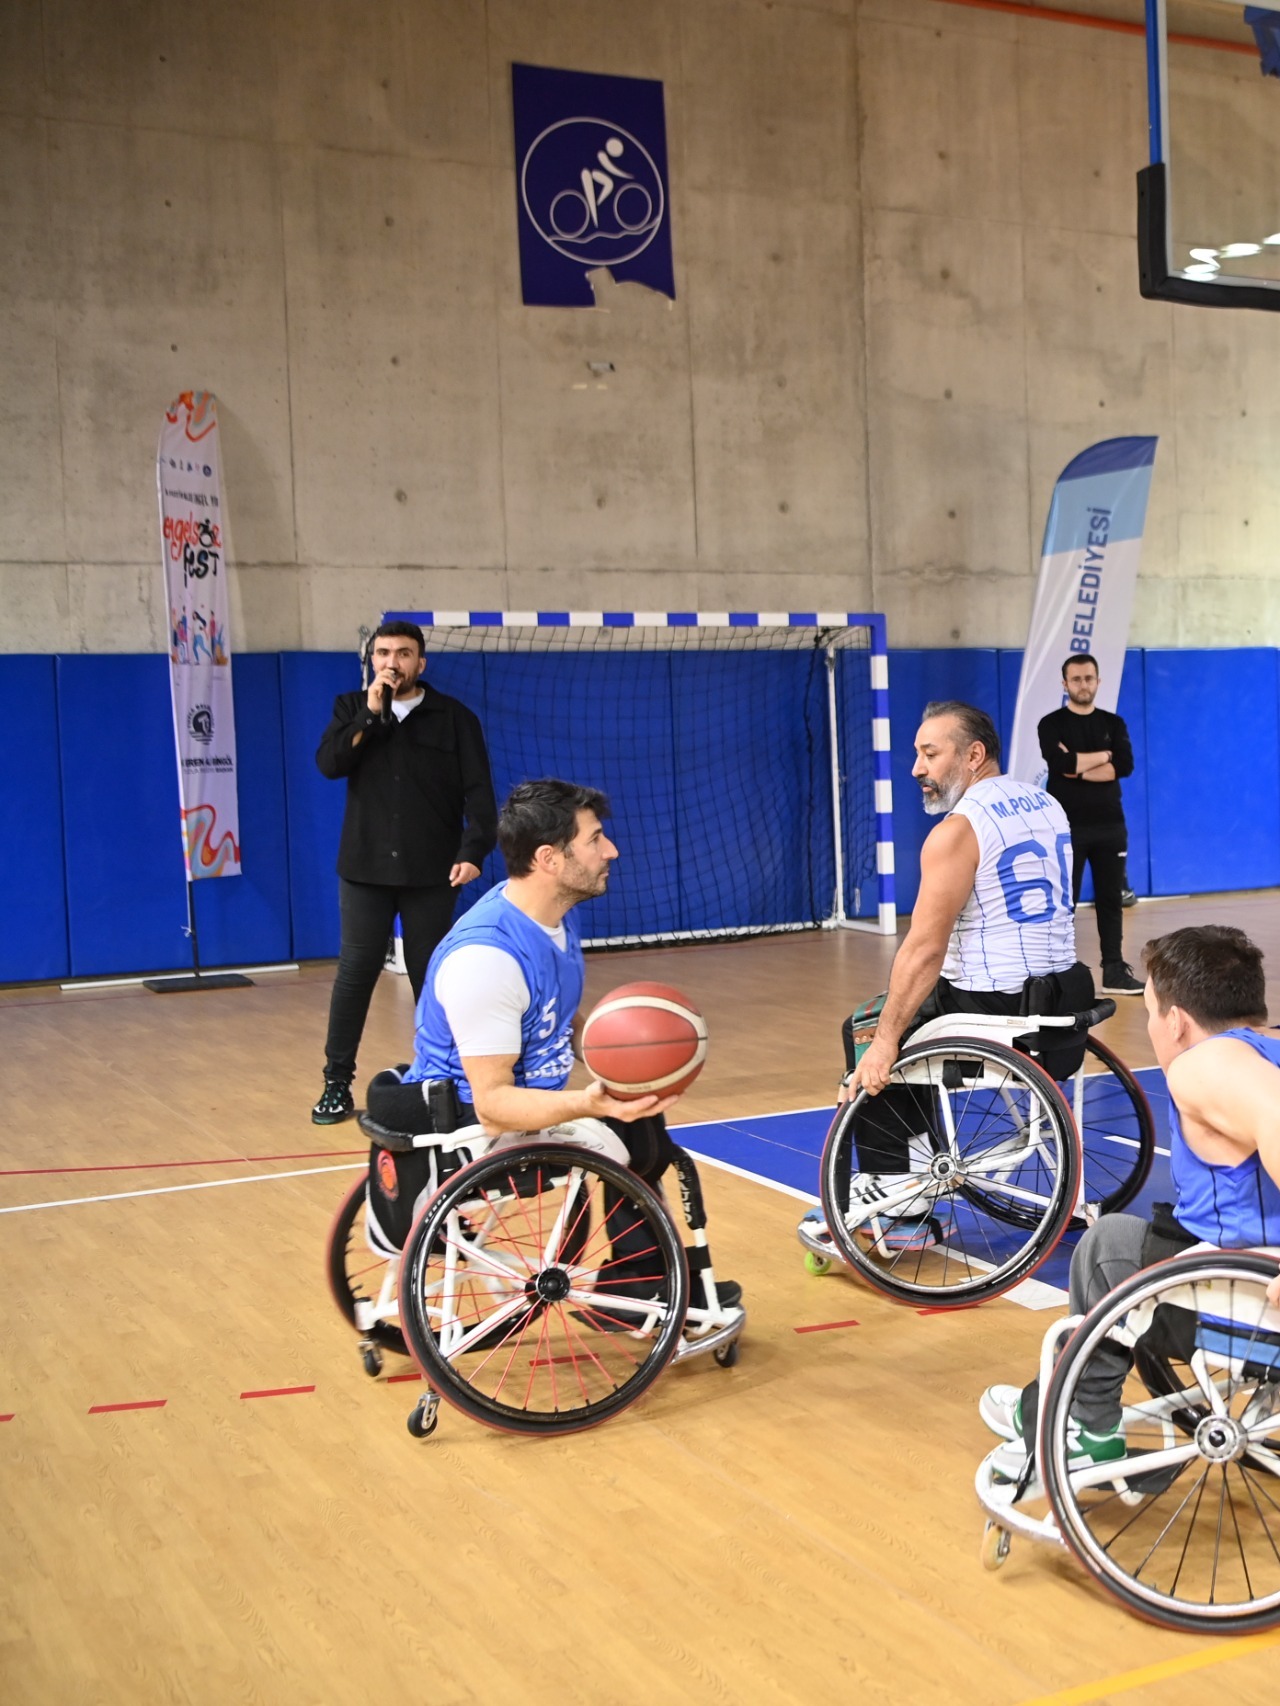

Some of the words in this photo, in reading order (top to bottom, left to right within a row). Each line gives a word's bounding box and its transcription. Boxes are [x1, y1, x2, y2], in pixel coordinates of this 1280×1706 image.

[1069, 507, 1112, 655] BELEDİYESİ
[990, 791, 1053, 819] M.POLAT
[538, 996, 557, 1039] 5
[424, 1194, 447, 1224] KENDA
